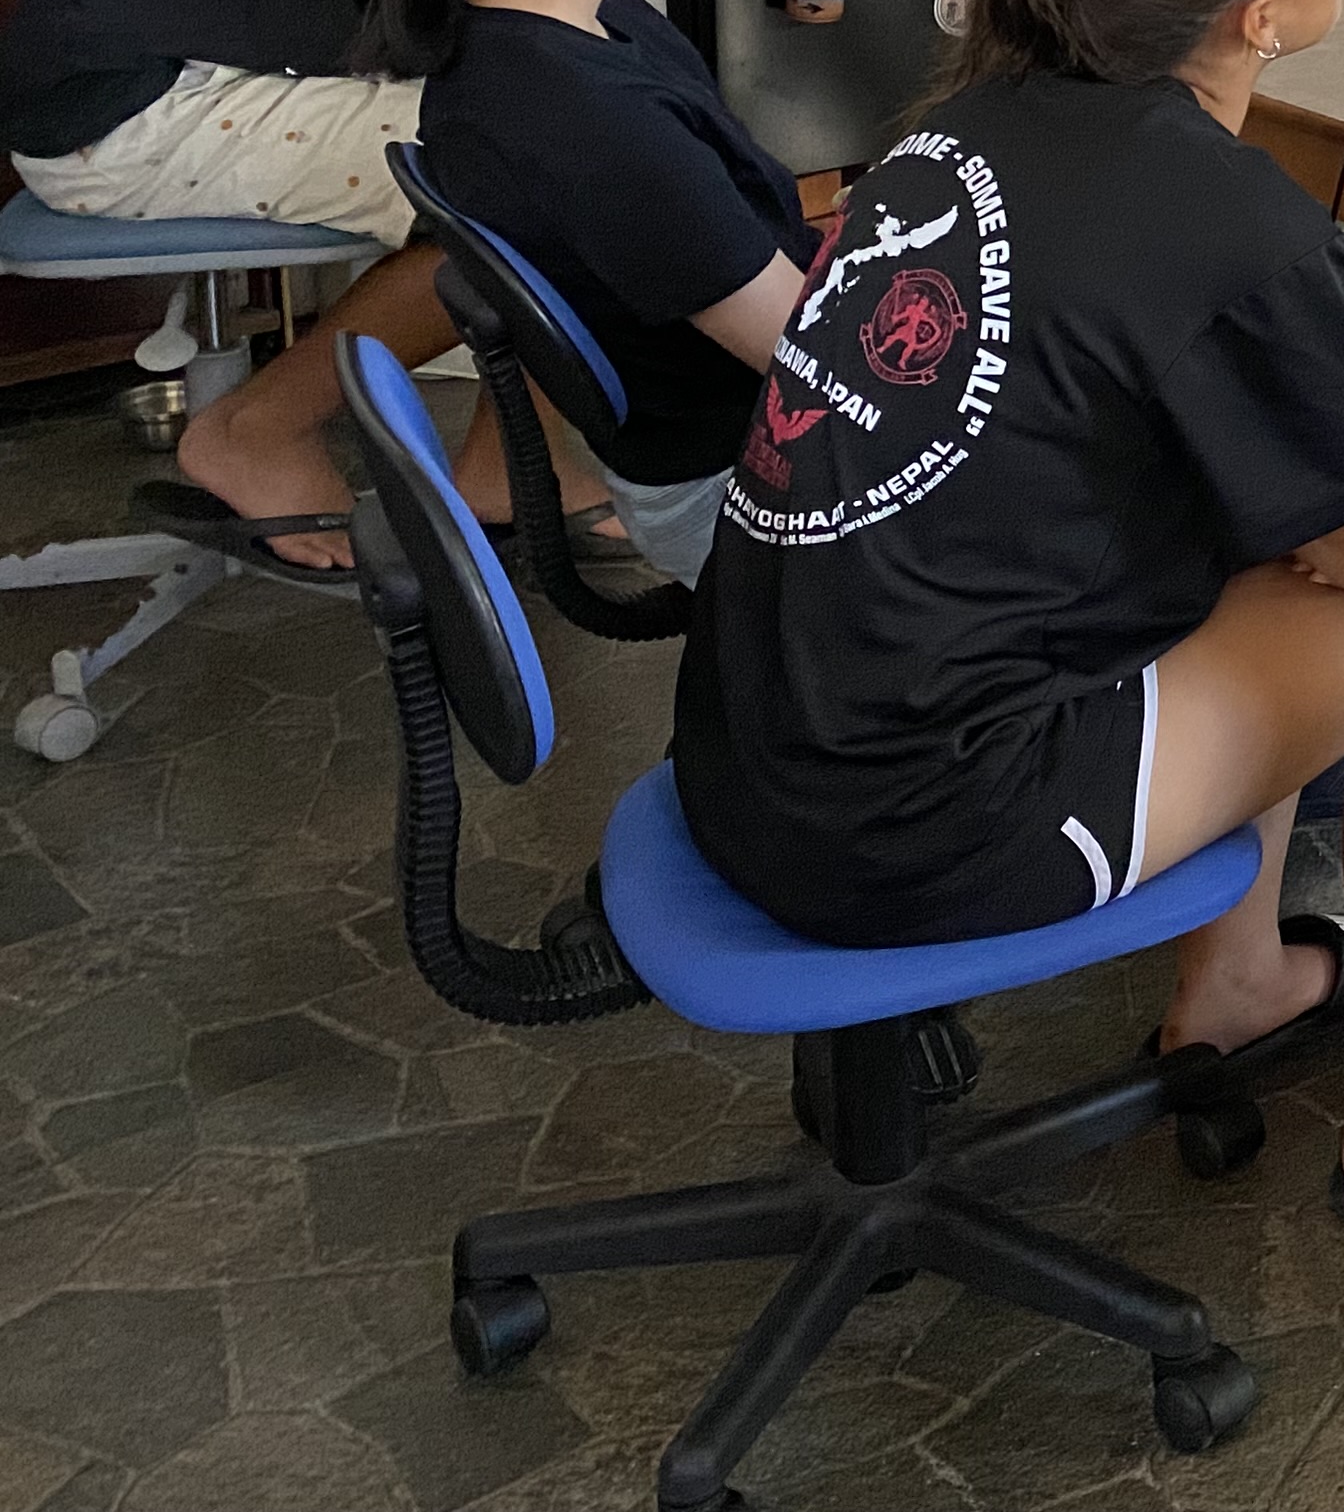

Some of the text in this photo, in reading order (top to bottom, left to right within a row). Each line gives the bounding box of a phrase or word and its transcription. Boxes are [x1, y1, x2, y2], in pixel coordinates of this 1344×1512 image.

[956, 155, 1007, 237] SOME
[979, 239, 1011, 343] GAVE
[866, 440, 954, 506] NEPAL
